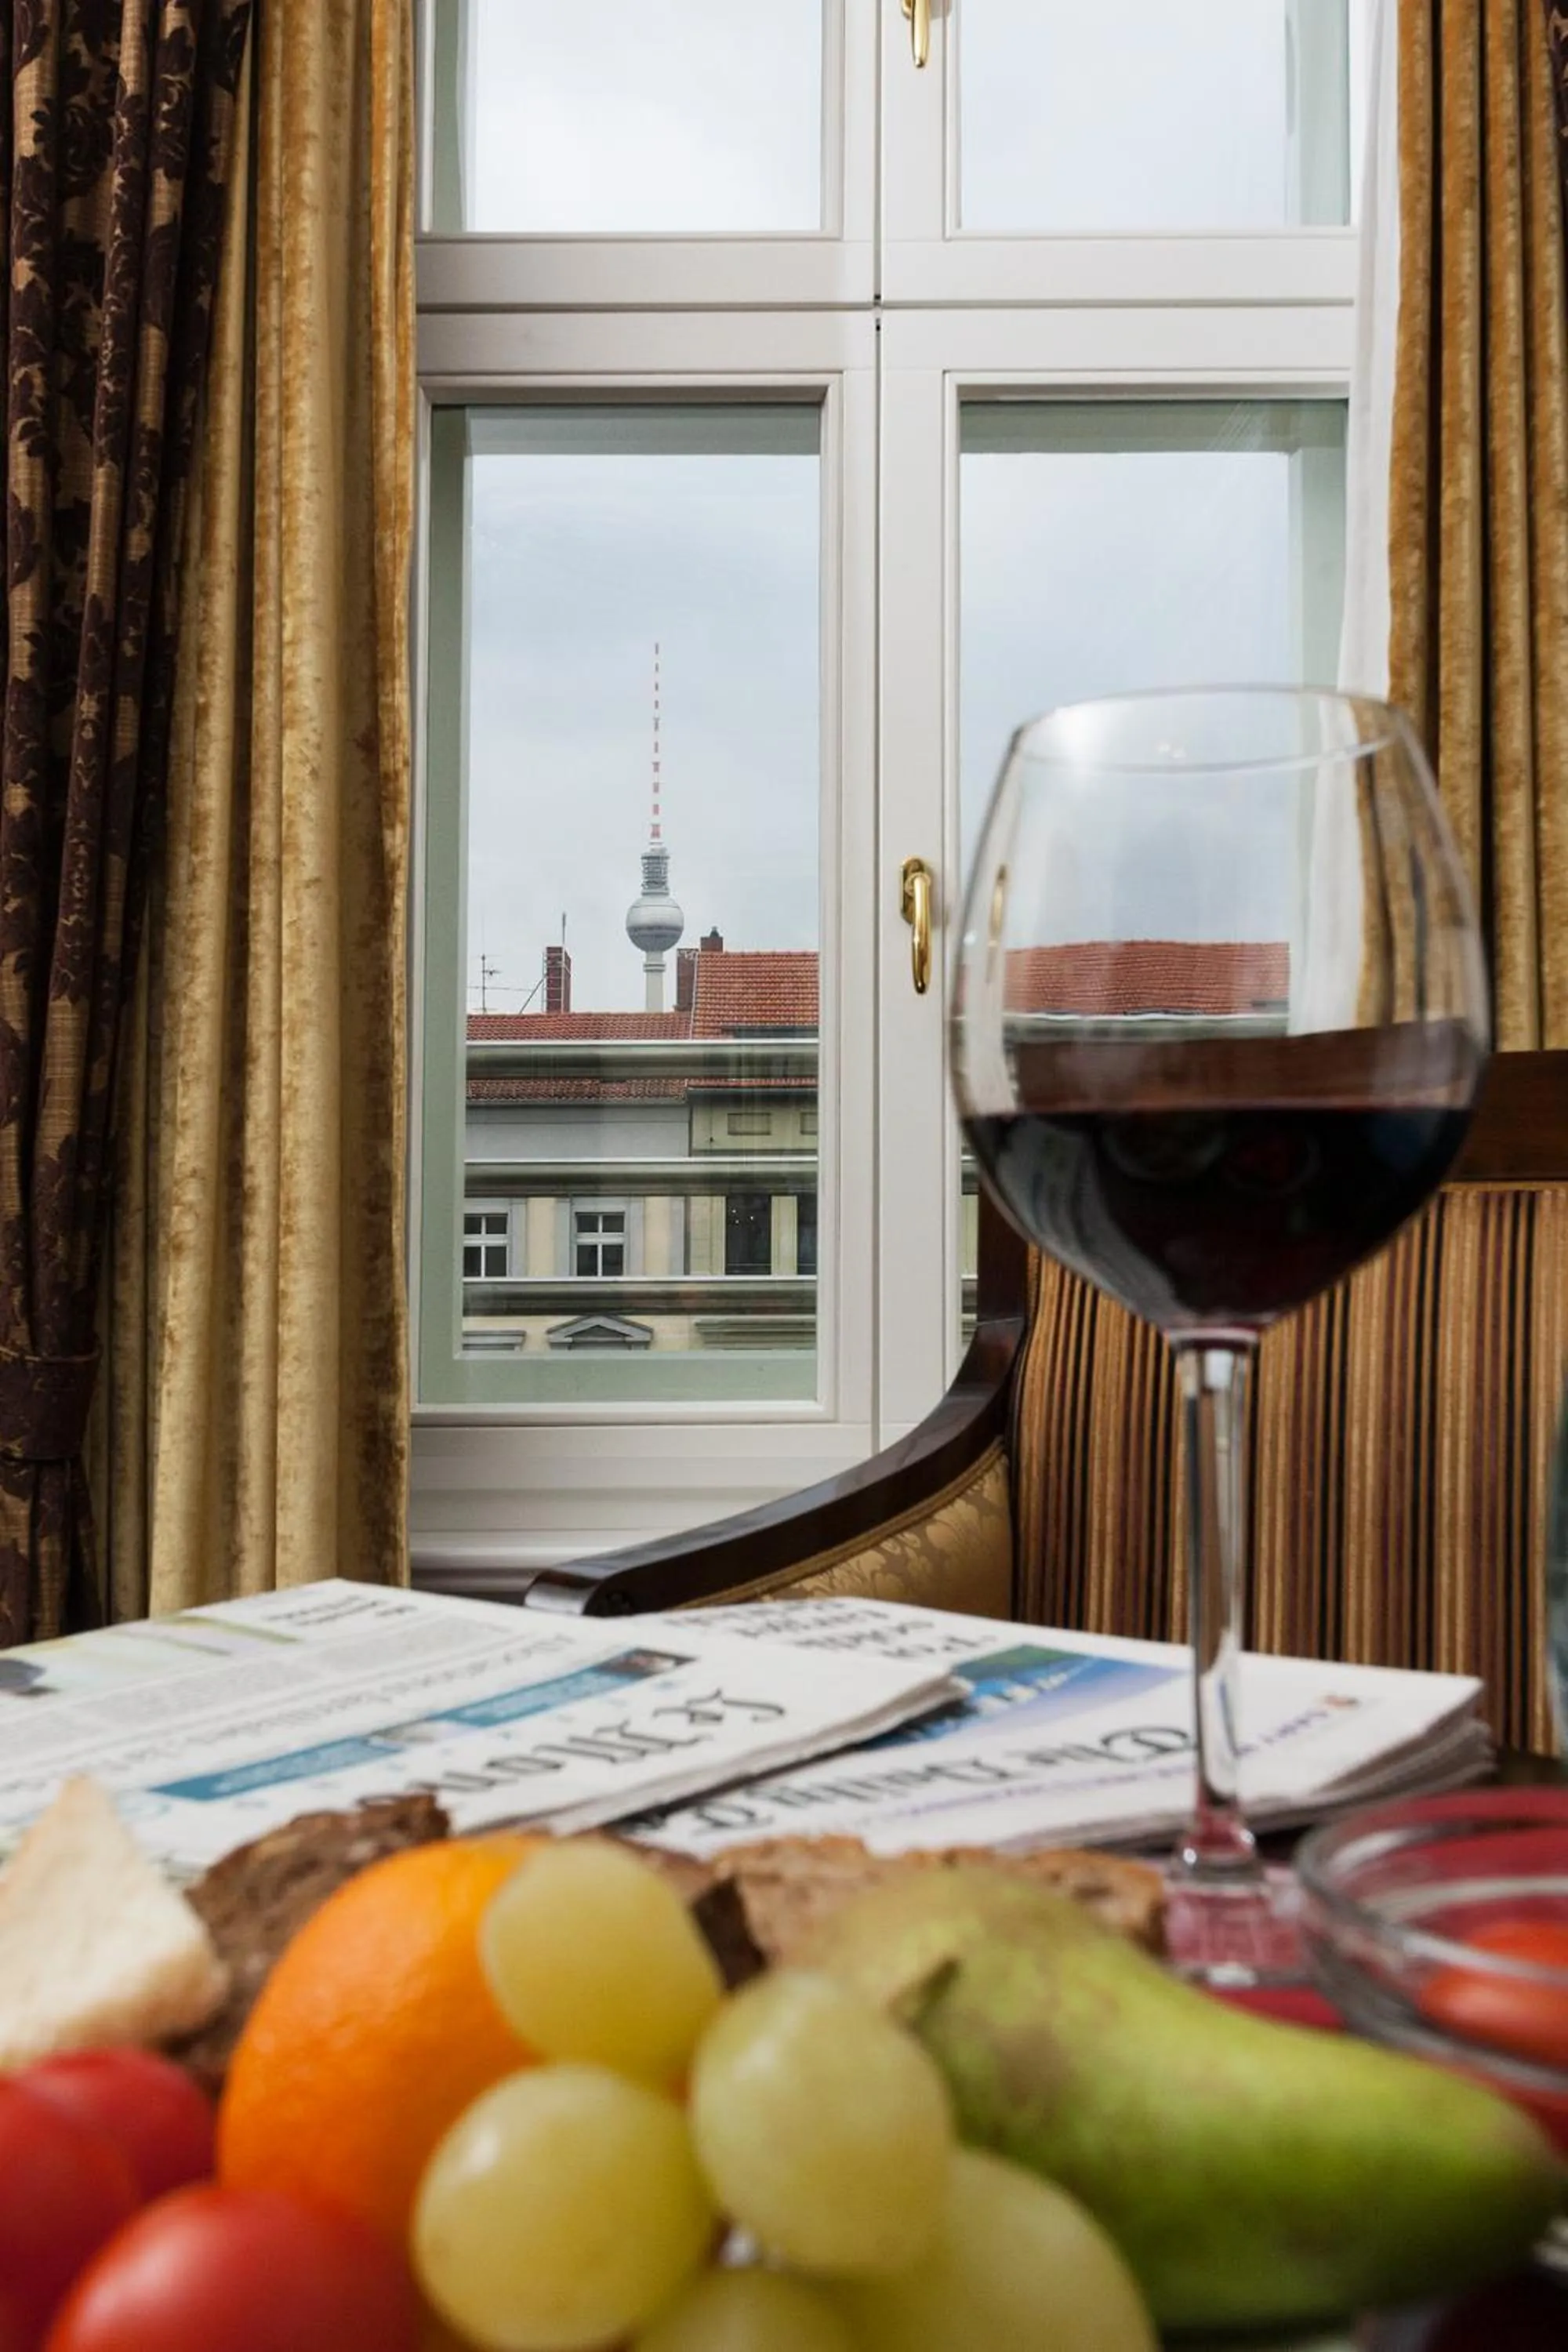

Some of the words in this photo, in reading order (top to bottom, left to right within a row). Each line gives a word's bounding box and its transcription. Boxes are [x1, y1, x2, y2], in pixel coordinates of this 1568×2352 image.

[652, 1687, 786, 1725] Le
[405, 1719, 711, 1795] Mon
[1005, 1725, 1199, 1764] The
